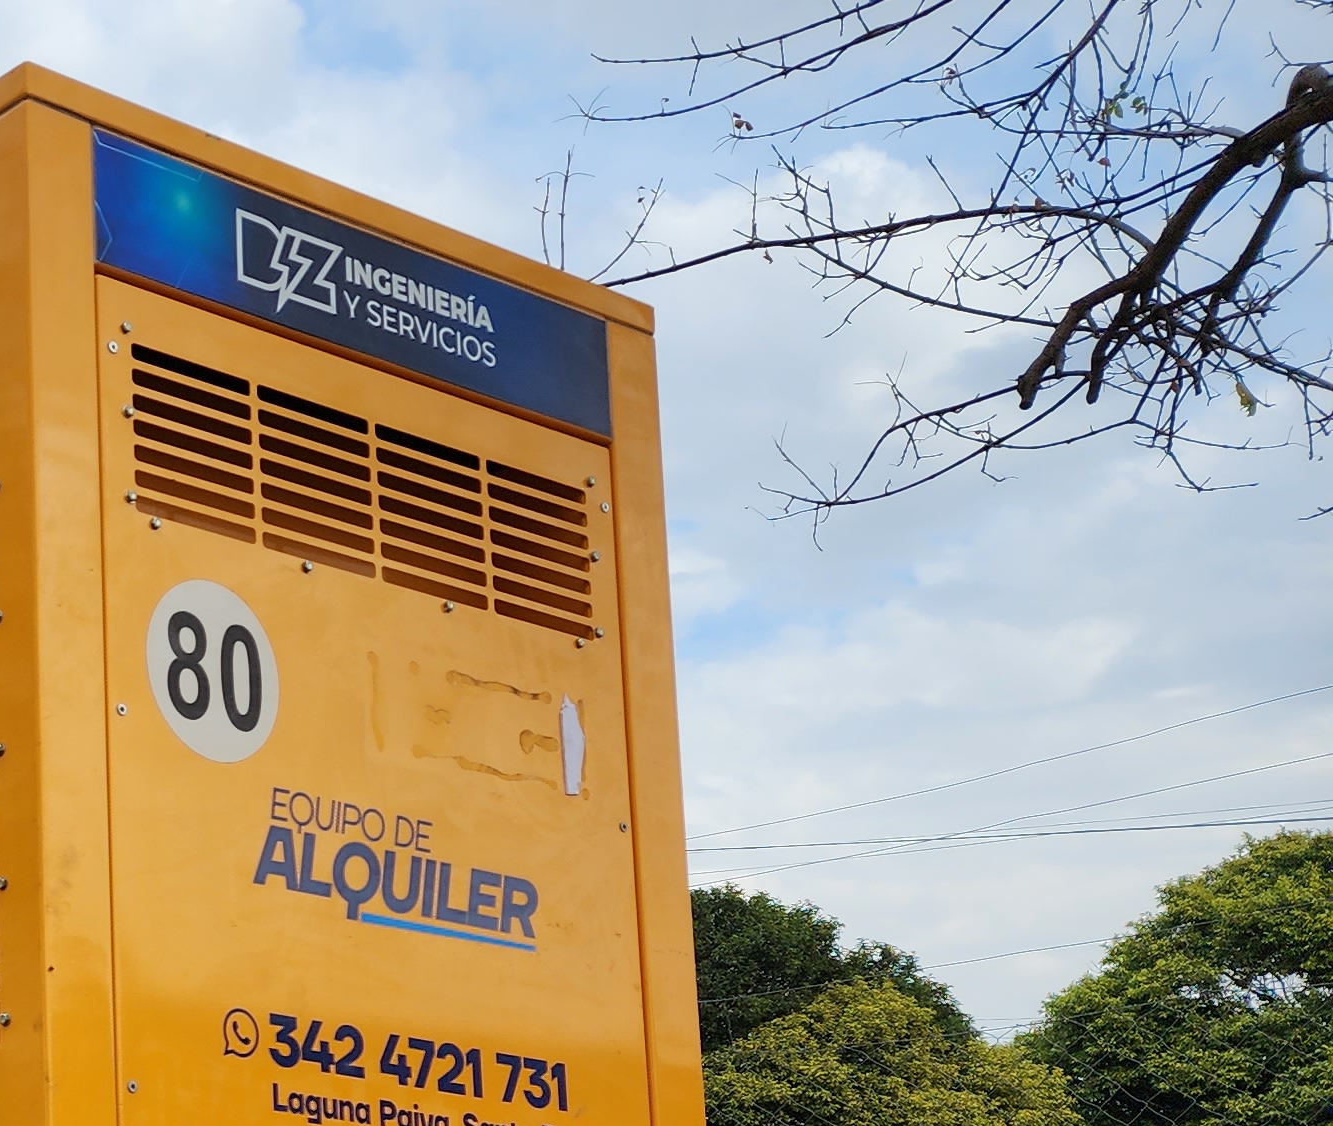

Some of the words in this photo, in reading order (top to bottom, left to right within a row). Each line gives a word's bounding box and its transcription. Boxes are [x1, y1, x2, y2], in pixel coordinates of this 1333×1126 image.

[343, 289, 362, 319] Y
[366, 300, 497, 368] SERVICIOS
[345, 255, 494, 333] INGENIERÍA
[167, 610, 262, 732] 80
[270, 787, 386, 842] EQUIPO
[395, 815, 433, 854] DE
[252, 825, 539, 939] ALQUILER
[268, 1012, 366, 1079] 342
[380, 1034, 483, 1098] 4721
[496, 1052, 569, 1111] 731
[273, 1083, 370, 1125] Laguna
